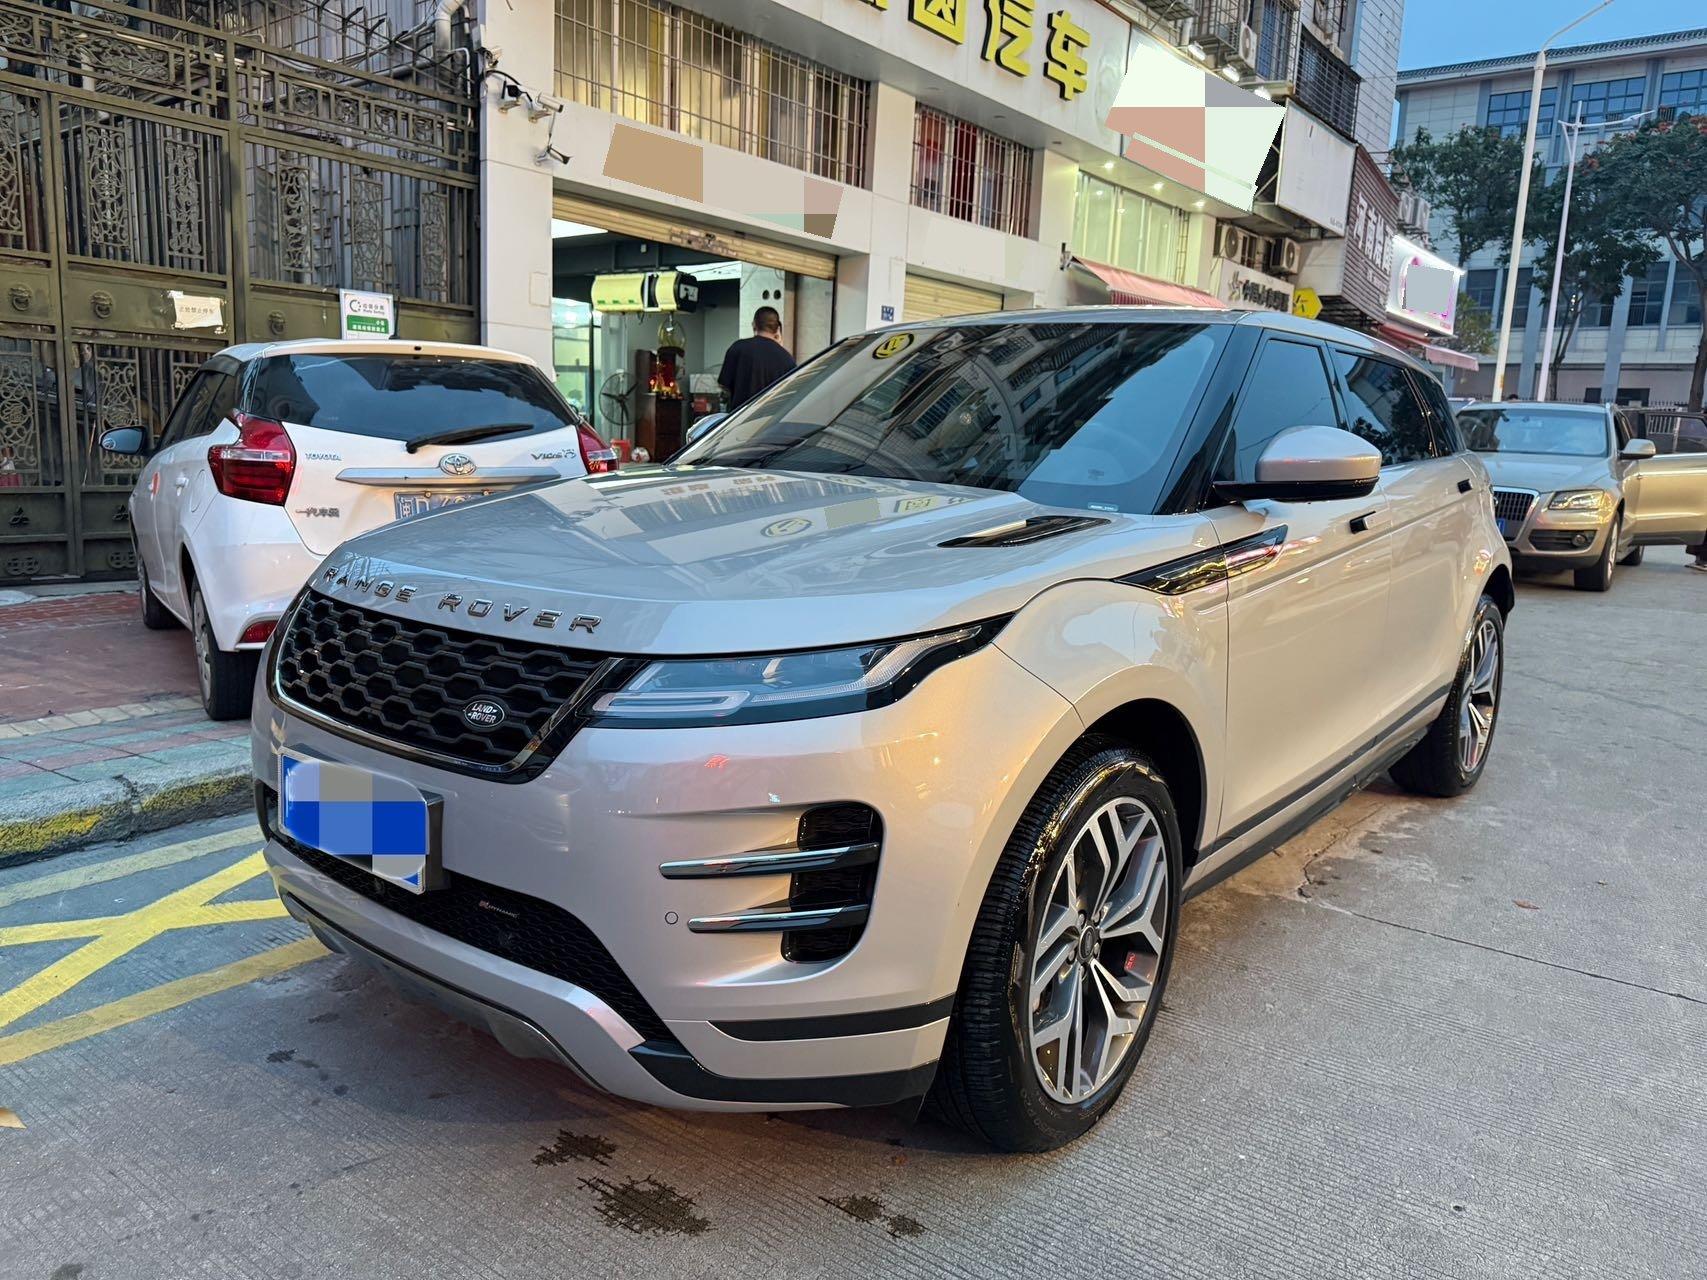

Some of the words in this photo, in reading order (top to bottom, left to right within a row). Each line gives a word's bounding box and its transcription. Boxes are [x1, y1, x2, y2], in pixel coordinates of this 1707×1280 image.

[305, 453, 342, 461] TOYOTA
[323, 565, 418, 604] RANGE
[437, 592, 602, 635] ROVER
[471, 703, 494, 714] LAND
[470, 711, 497, 724] ROVER
